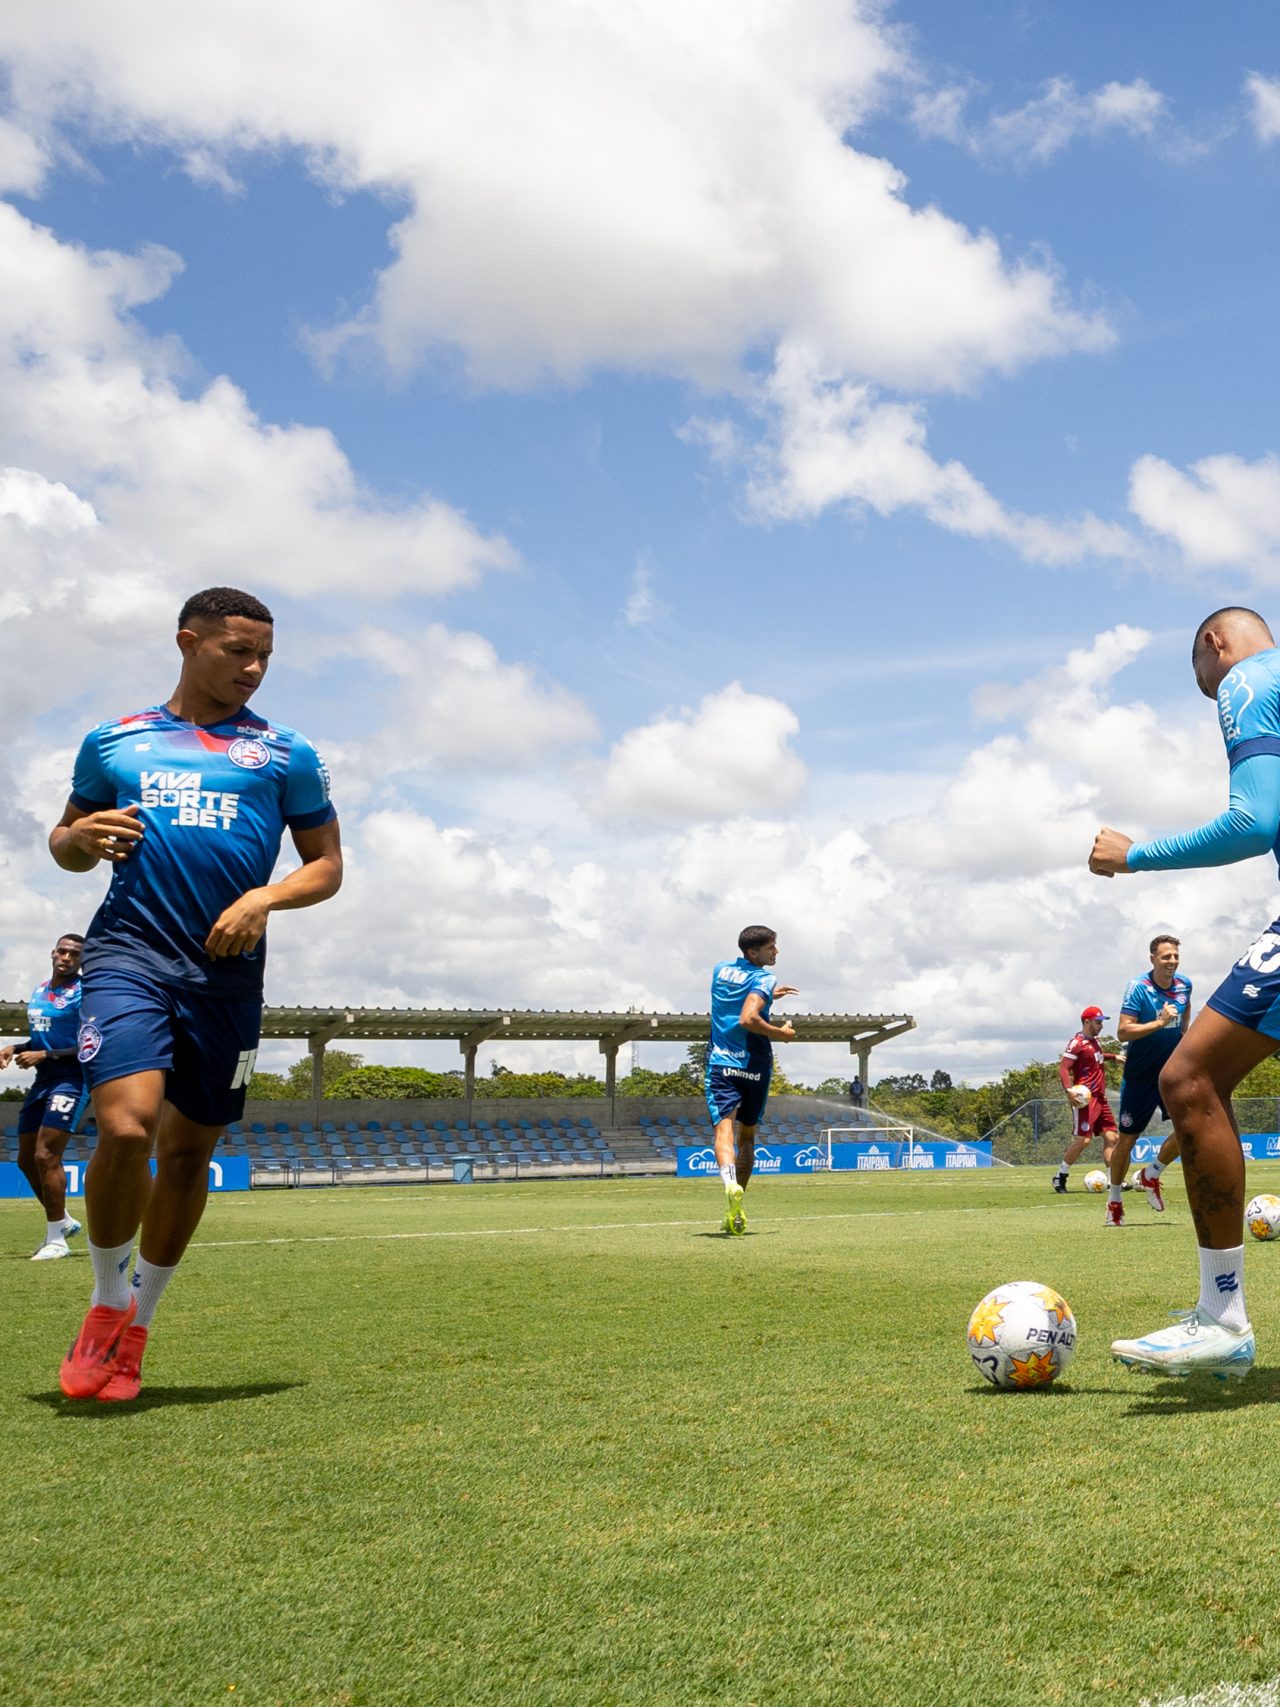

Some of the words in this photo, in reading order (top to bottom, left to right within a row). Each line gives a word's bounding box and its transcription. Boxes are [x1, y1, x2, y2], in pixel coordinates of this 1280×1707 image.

[140, 771, 202, 790] VIVA
[141, 789, 240, 810] SORTE
[171, 807, 238, 831] .BET
[723, 1067, 761, 1081] Unimed
[857, 1156, 890, 1169] ITAIPAVA
[902, 1155, 934, 1168] ITAIPAVA
[945, 1155, 977, 1168] ITAIPAVA
